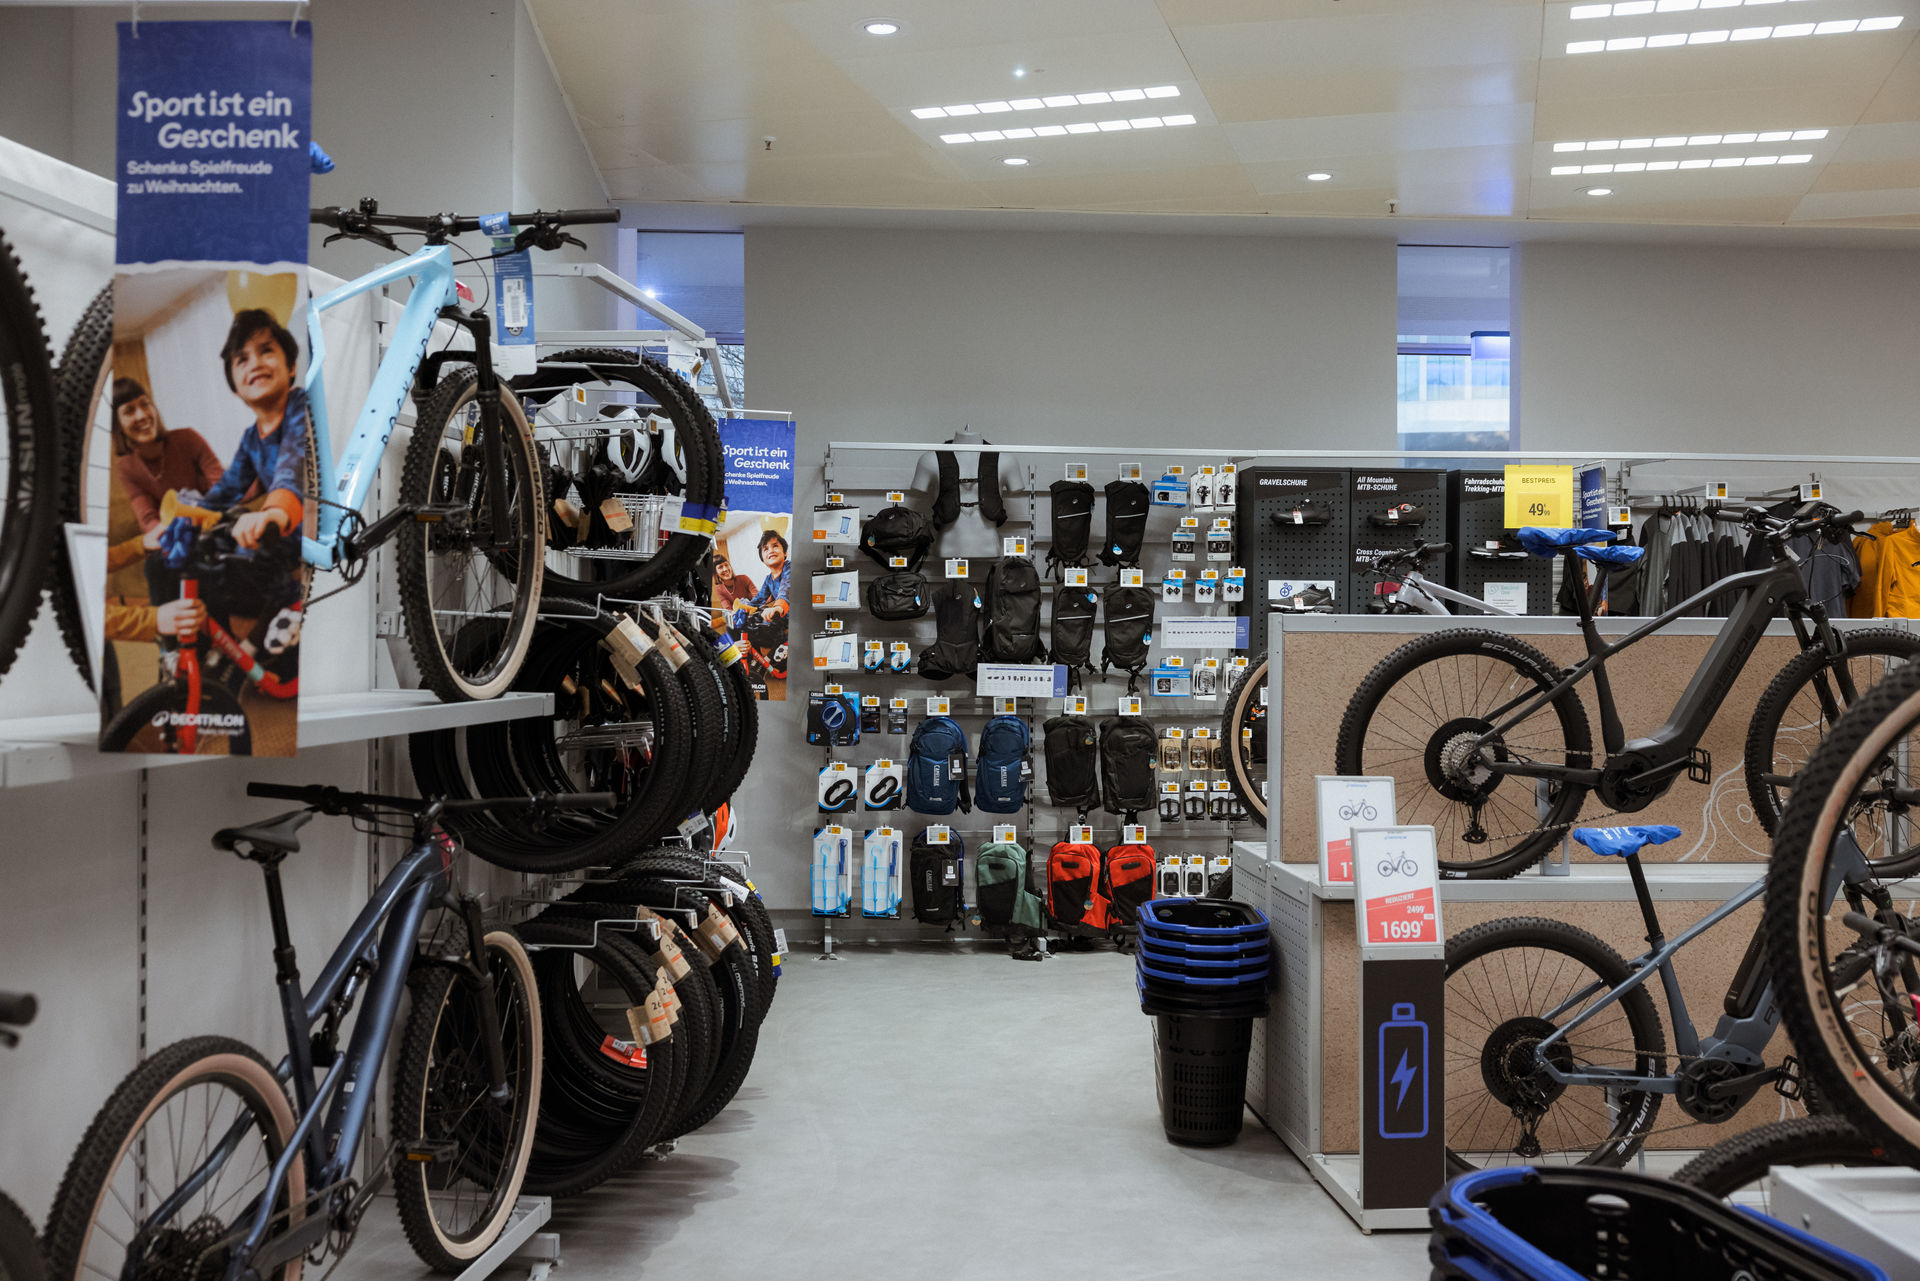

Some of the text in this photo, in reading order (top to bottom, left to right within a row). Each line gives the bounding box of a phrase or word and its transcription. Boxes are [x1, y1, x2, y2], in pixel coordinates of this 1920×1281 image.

[128, 90, 292, 123] Sport ist ein
[158, 122, 299, 149] Geschenk
[126, 160, 273, 177] Schenke Spielfreude
[126, 180, 244, 194] zu Weihnachten.
[722, 444, 788, 458] Sport ist ein
[734, 457, 790, 470] Geschenk
[1259, 478, 1308, 487] GRAVELSCHUHE
[533, 471, 545, 536] BARZO
[1528, 503, 1544, 516] 49
[711, 669, 728, 705] MICHELIN
[1385, 892, 1415, 905] REDUZIERT
[1616, 1057, 1656, 1156] SCWALBE
